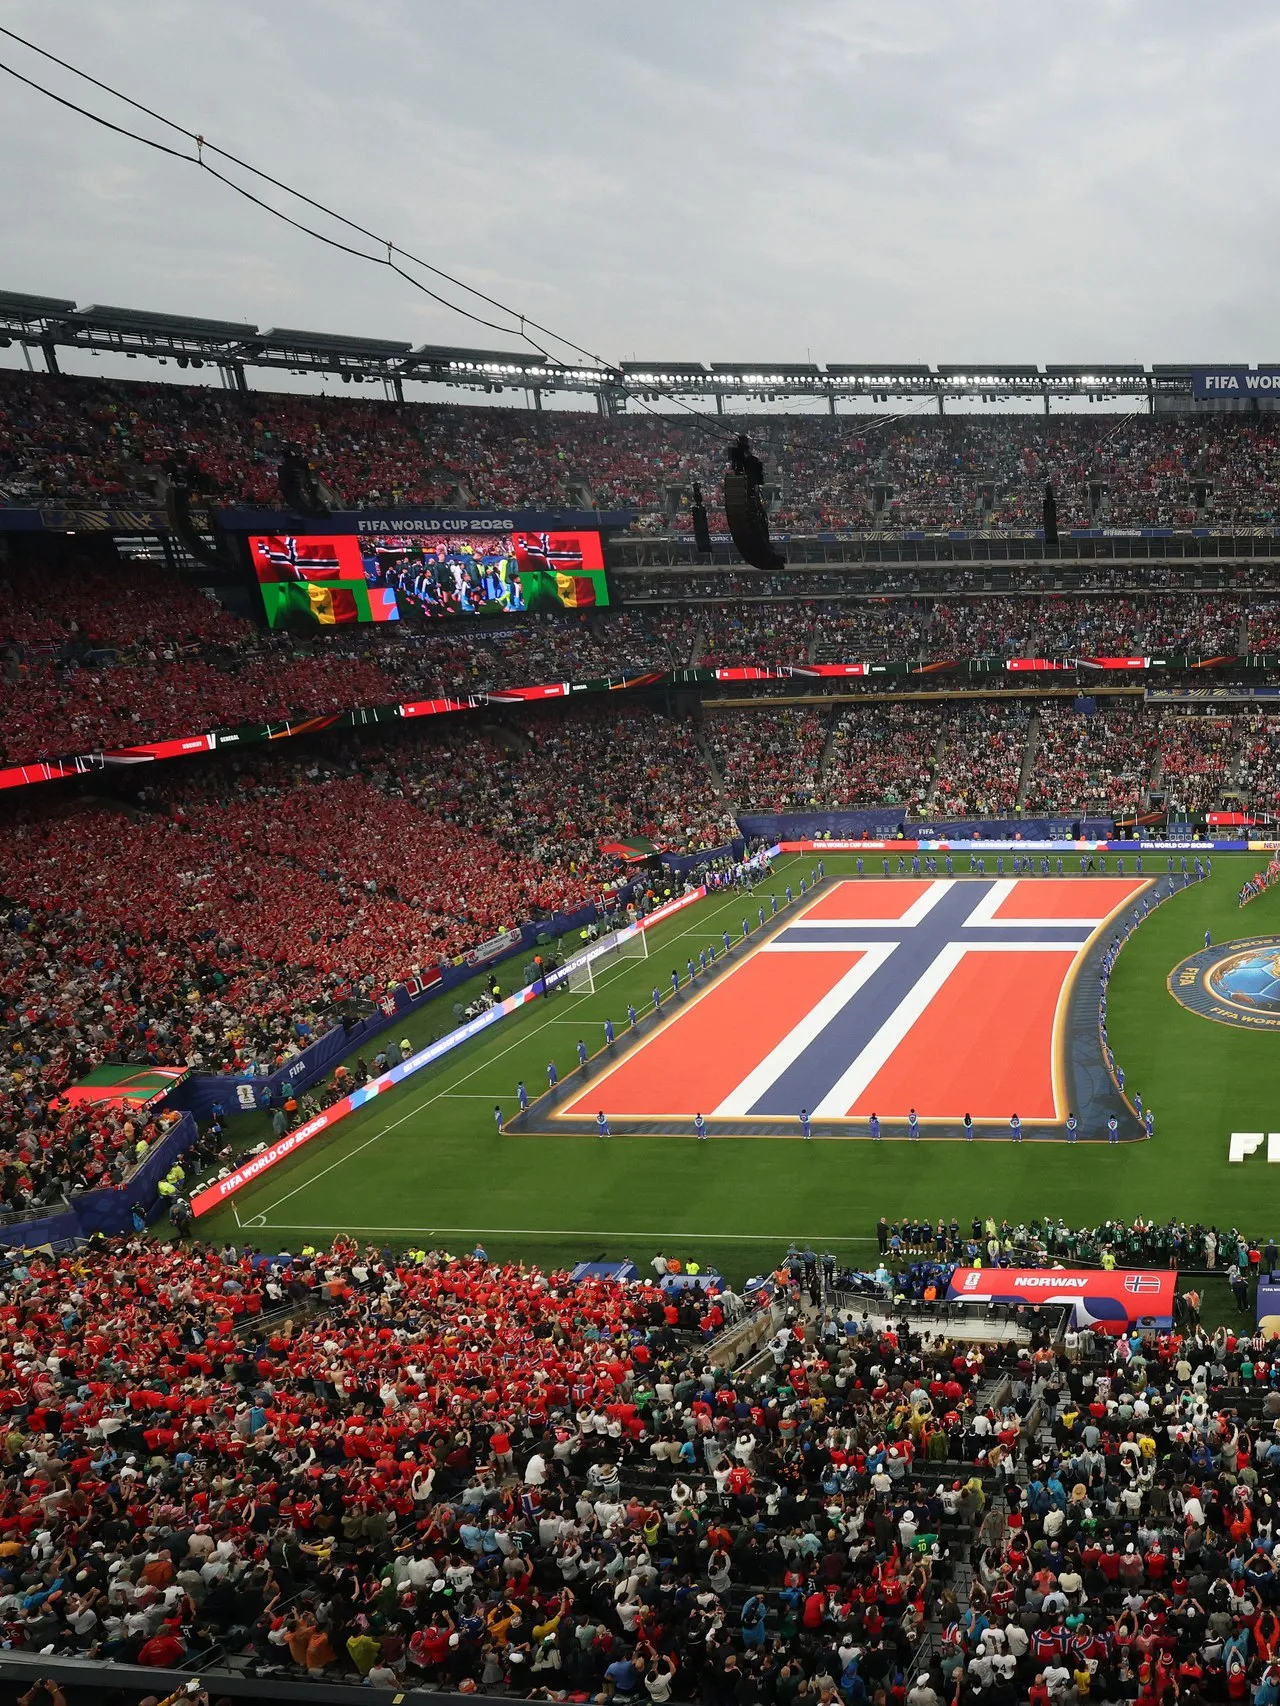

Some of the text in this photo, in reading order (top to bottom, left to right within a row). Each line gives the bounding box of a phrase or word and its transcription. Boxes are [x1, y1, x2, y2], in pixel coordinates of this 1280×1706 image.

[1205, 376, 1239, 390] FIFA
[358, 520, 514, 531] FIFA WORLD CUP 2026
[545, 974, 558, 986] FIFA
[557, 962, 577, 978] WORLD
[576, 956, 587, 967] CUP
[1180, 967, 1200, 986] FIFA
[1210, 1007, 1237, 1019] FIFA
[289, 1061, 306, 1079] FIFA
[220, 1116, 328, 1195] FIFA WORLD CUP 2026
[1014, 1277, 1089, 1287] NORWAY
[193, 1462, 207, 1472] 26
[736, 1476, 742, 1484] 9
[724, 1500, 730, 1509] 9
[298, 1511, 305, 1519] 9
[917, 1543, 927, 1552] 10
[452, 1577, 462, 1586] 10
[886, 1588, 893, 1596] 9
[183, 1629, 191, 1639] 9
[1000, 1664, 1006, 1673] 4
